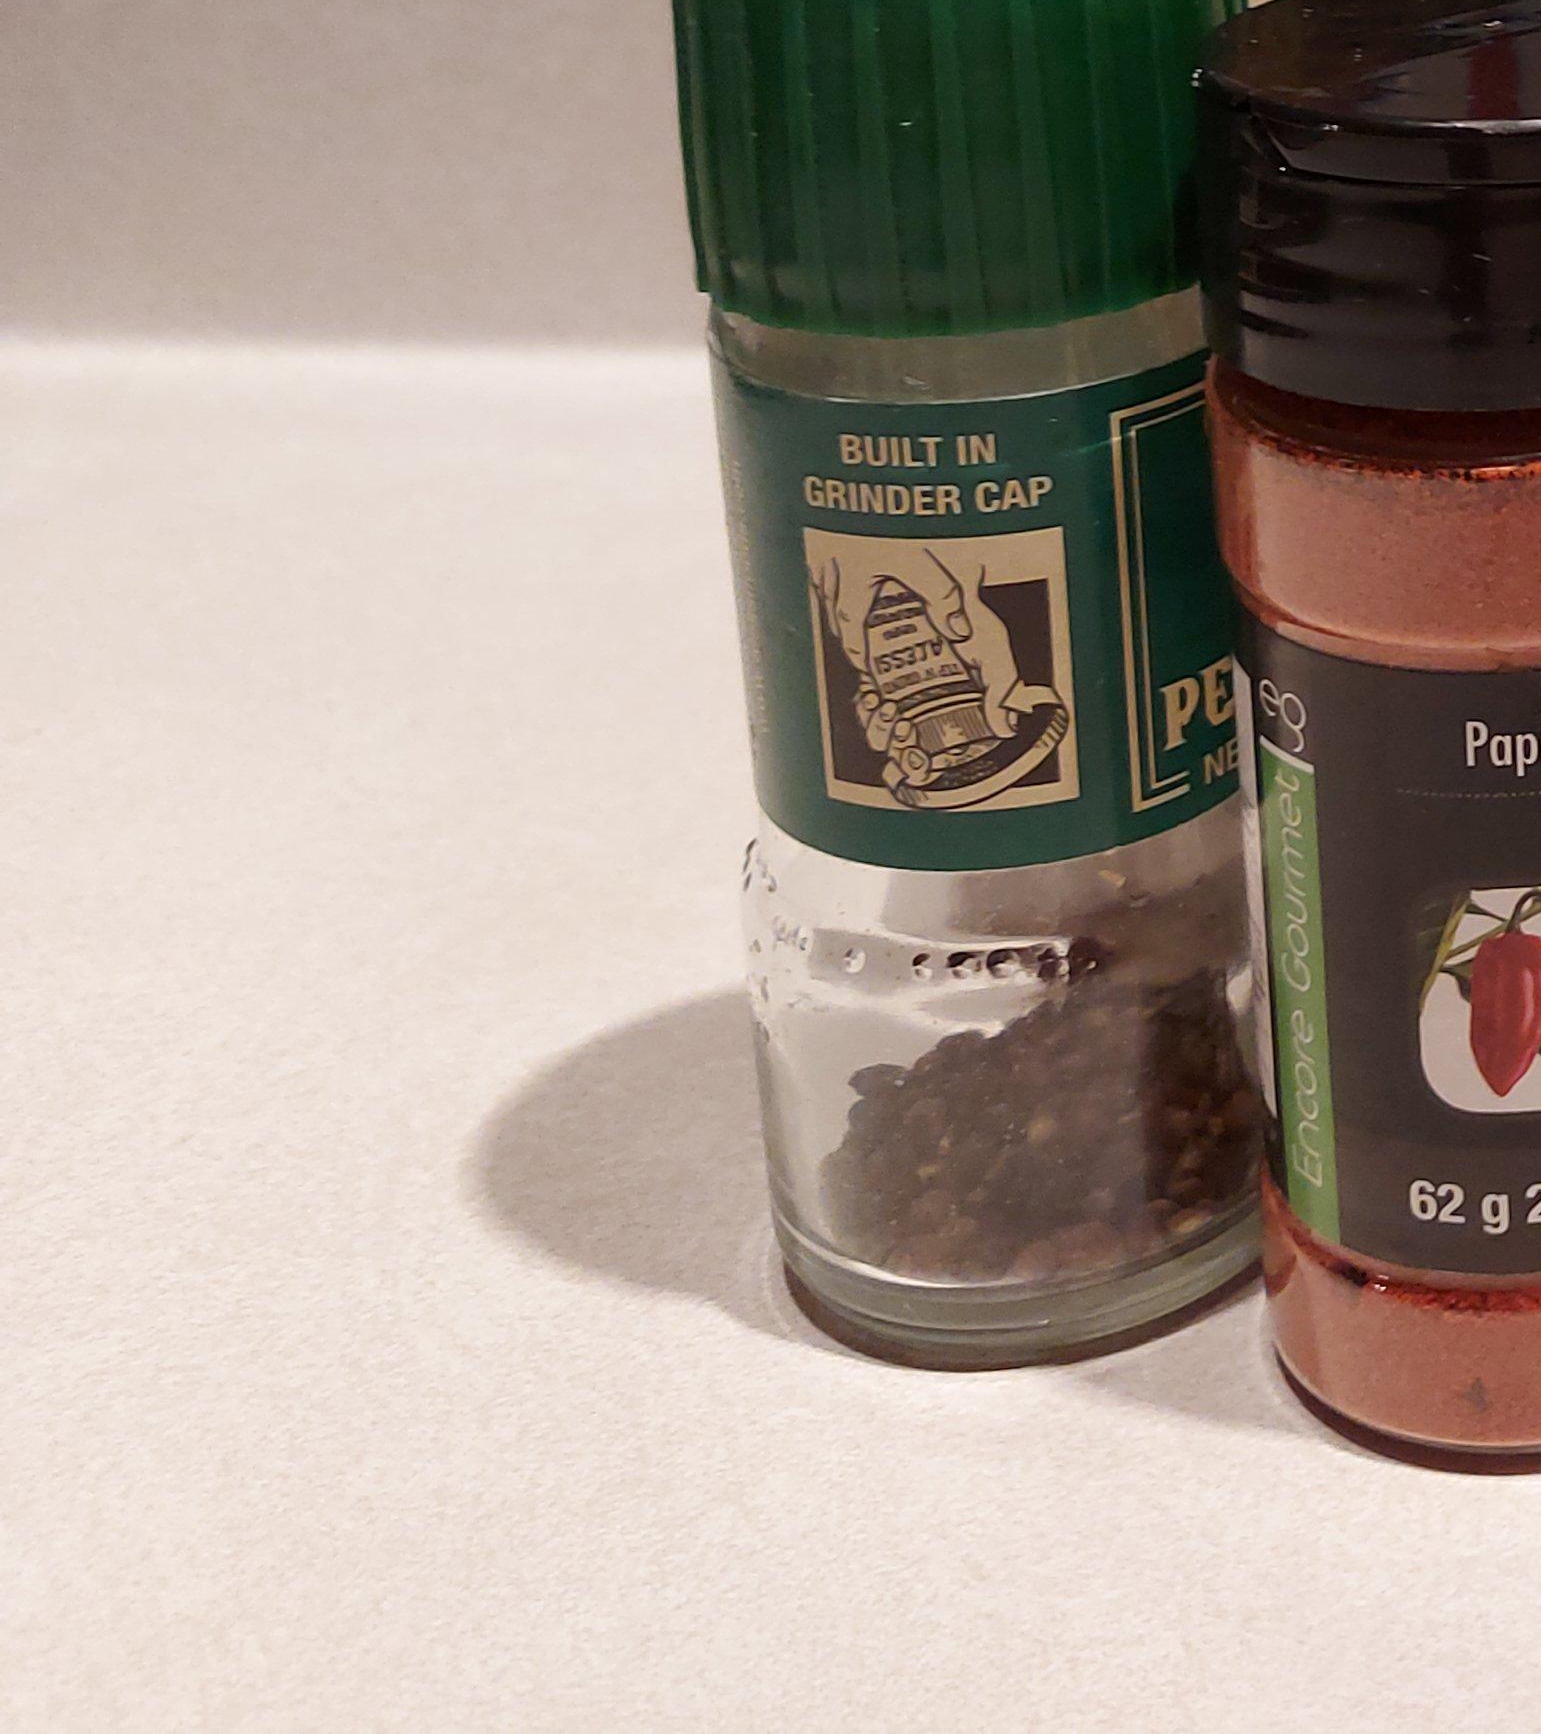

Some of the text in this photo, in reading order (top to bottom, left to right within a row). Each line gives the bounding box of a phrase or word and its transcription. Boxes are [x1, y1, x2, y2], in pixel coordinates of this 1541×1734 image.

[839, 433, 997, 468] BUILT IN
[803, 475, 1054, 516] GRINDER CAP
[1275, 764, 1324, 1189] Encore Gourmet
[1408, 1177, 1466, 1225] 62
[1481, 1192, 1511, 1235] g
